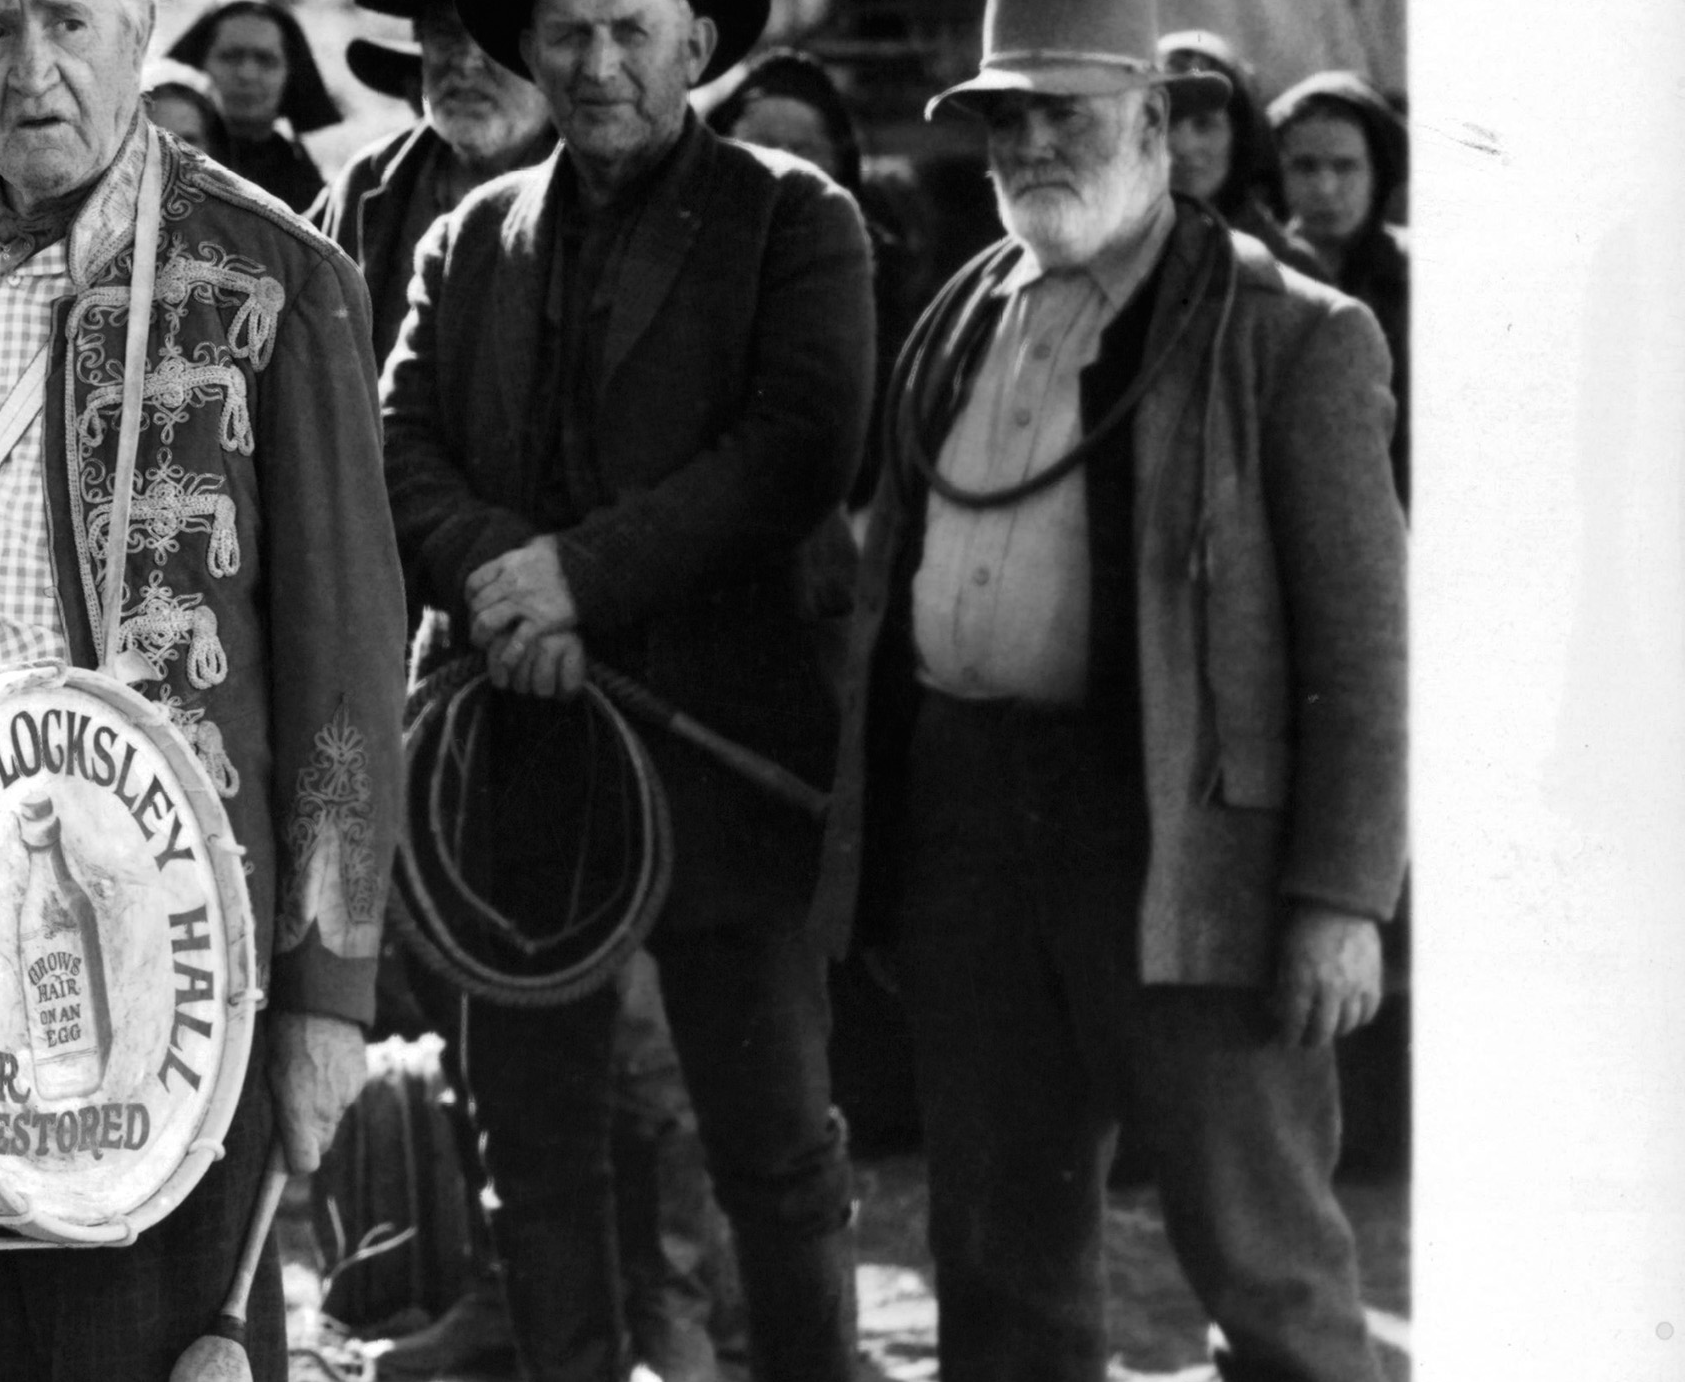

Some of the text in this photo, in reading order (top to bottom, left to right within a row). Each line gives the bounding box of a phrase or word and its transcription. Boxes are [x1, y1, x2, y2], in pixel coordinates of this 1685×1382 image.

[27, 951, 82, 986] GROWS
[37, 978, 82, 1003] HAIR
[157, 904, 214, 1093] HALL
[40, 1003, 81, 1025] ON AN
[46, 1023, 82, 1048] EGG
